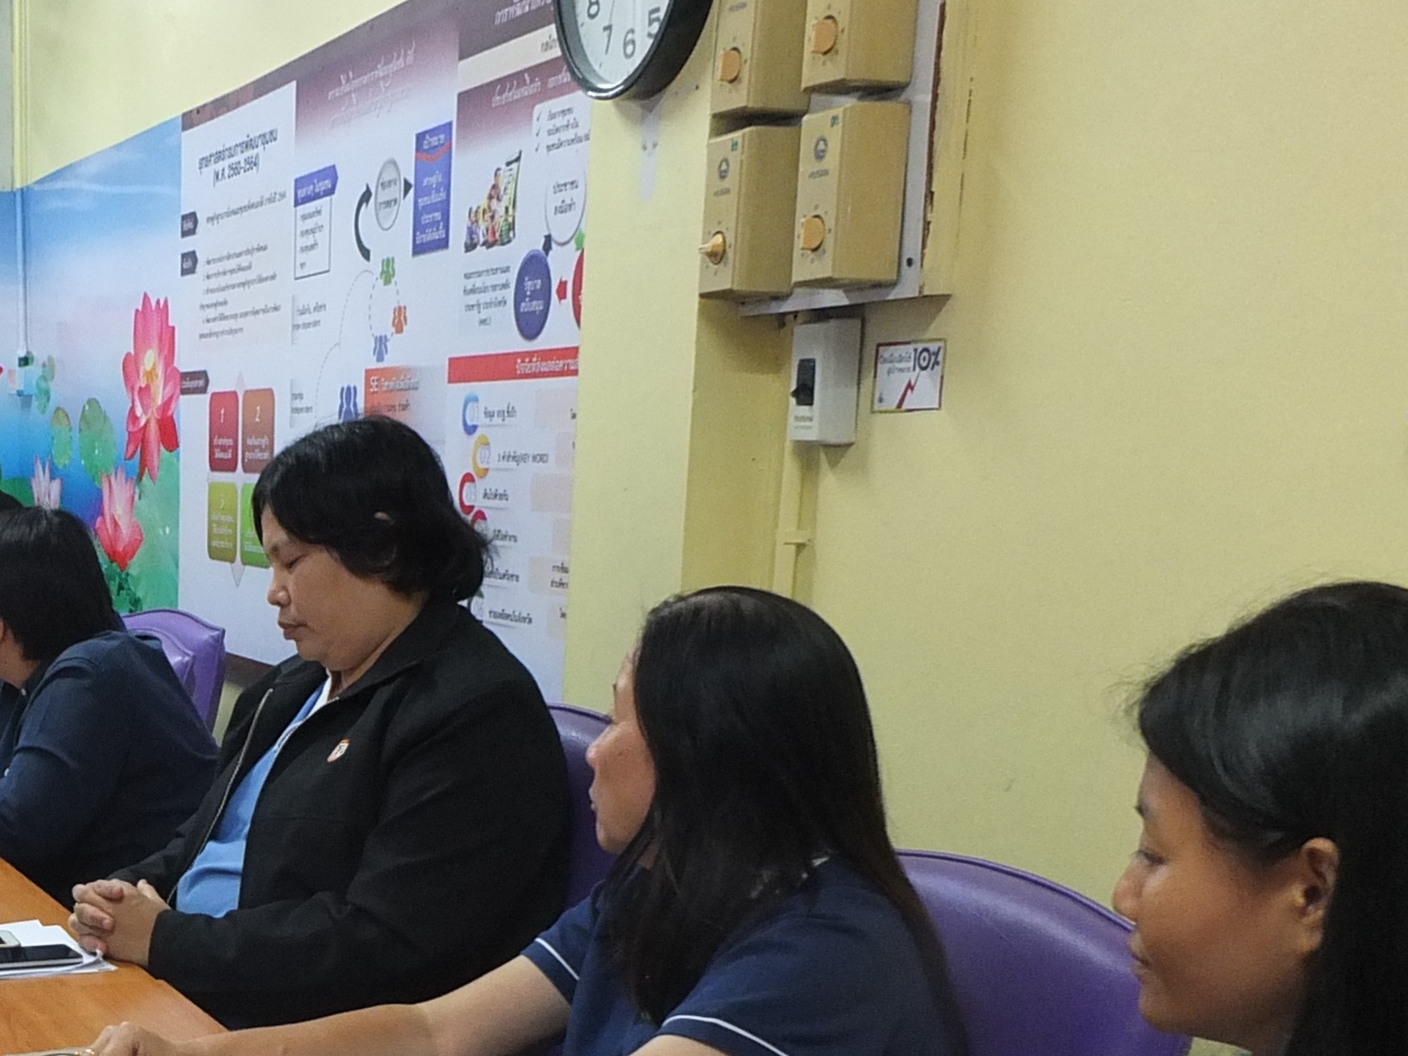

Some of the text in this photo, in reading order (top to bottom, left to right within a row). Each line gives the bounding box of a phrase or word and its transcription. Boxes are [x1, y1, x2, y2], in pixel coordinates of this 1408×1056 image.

[602, 23, 613, 55] 7
[647, 6, 661, 40] 5
[623, 28, 636, 60] 6
[912, 346, 942, 372] 10%
